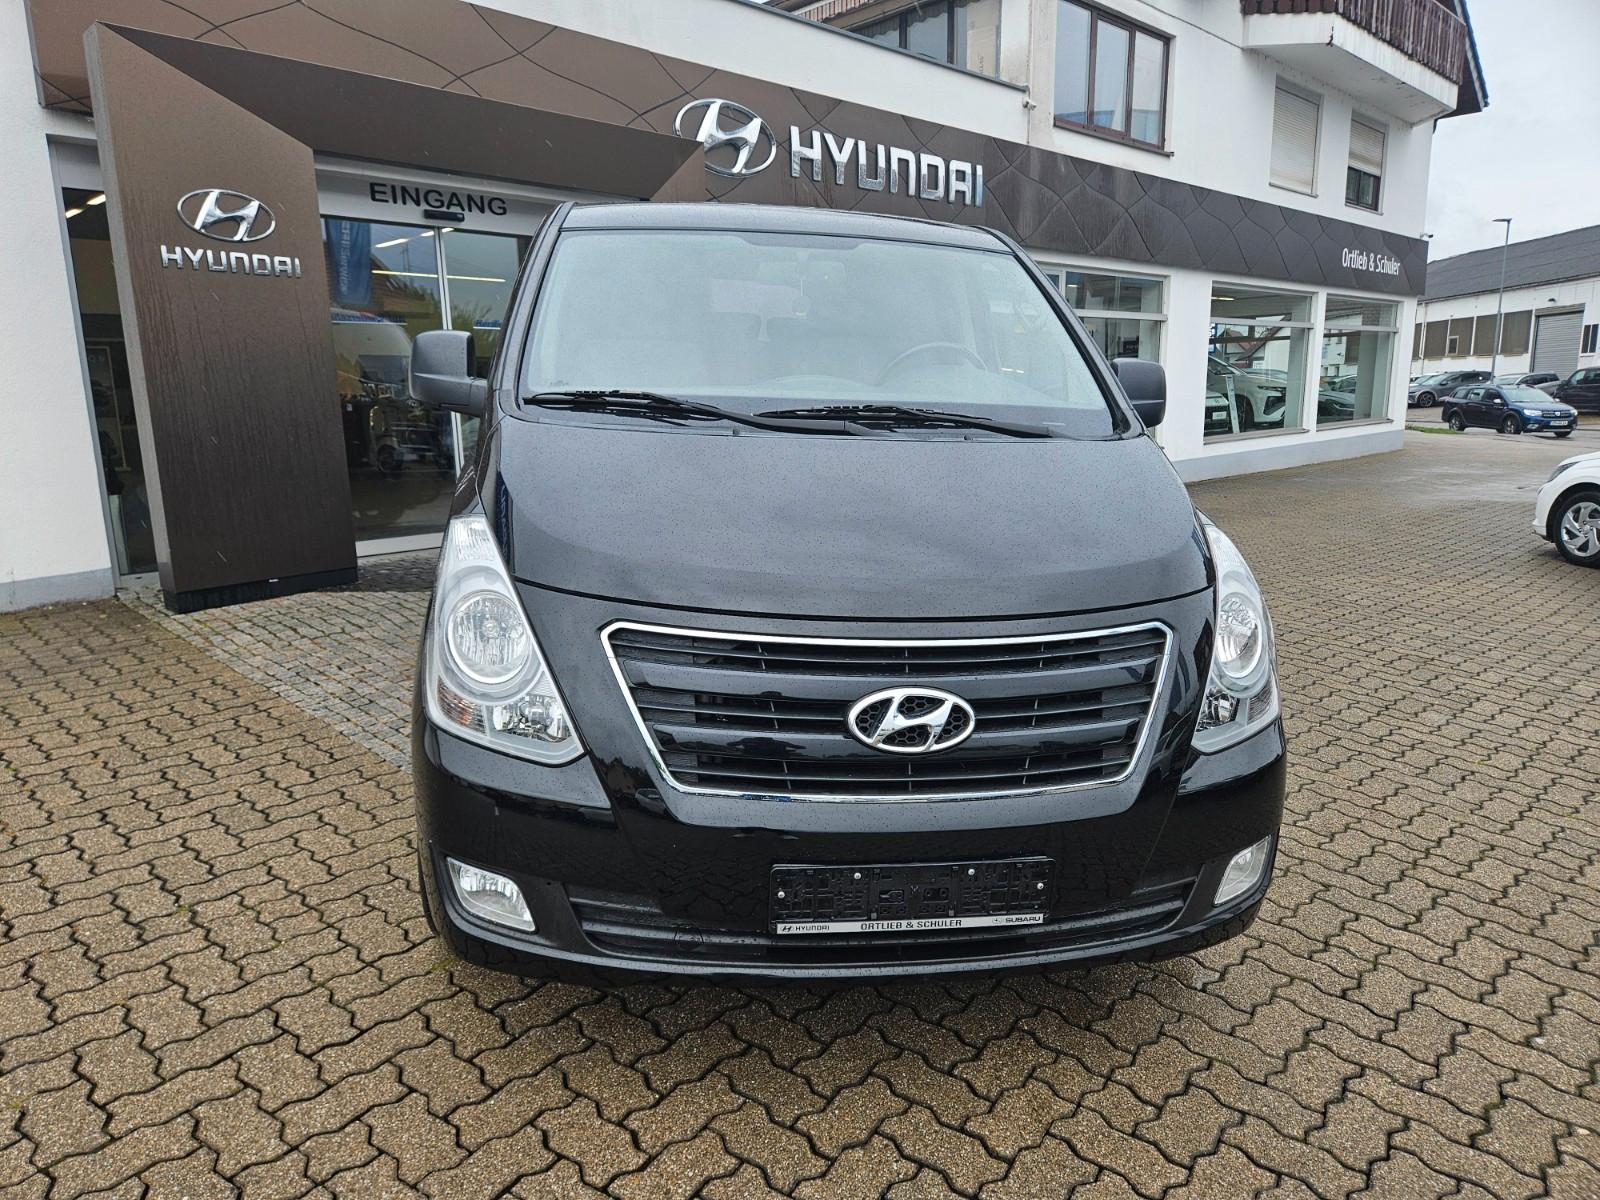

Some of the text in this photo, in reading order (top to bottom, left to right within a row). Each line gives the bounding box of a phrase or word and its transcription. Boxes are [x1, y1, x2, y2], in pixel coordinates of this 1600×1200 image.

[790, 125, 984, 208] HYUNDAI
[369, 182, 508, 216] EINGANG
[160, 244, 302, 279] HYUNDAI
[1342, 247, 1401, 276] Ortlieb & Schuler
[860, 919, 962, 931] ORTLIEB & SCHULER
